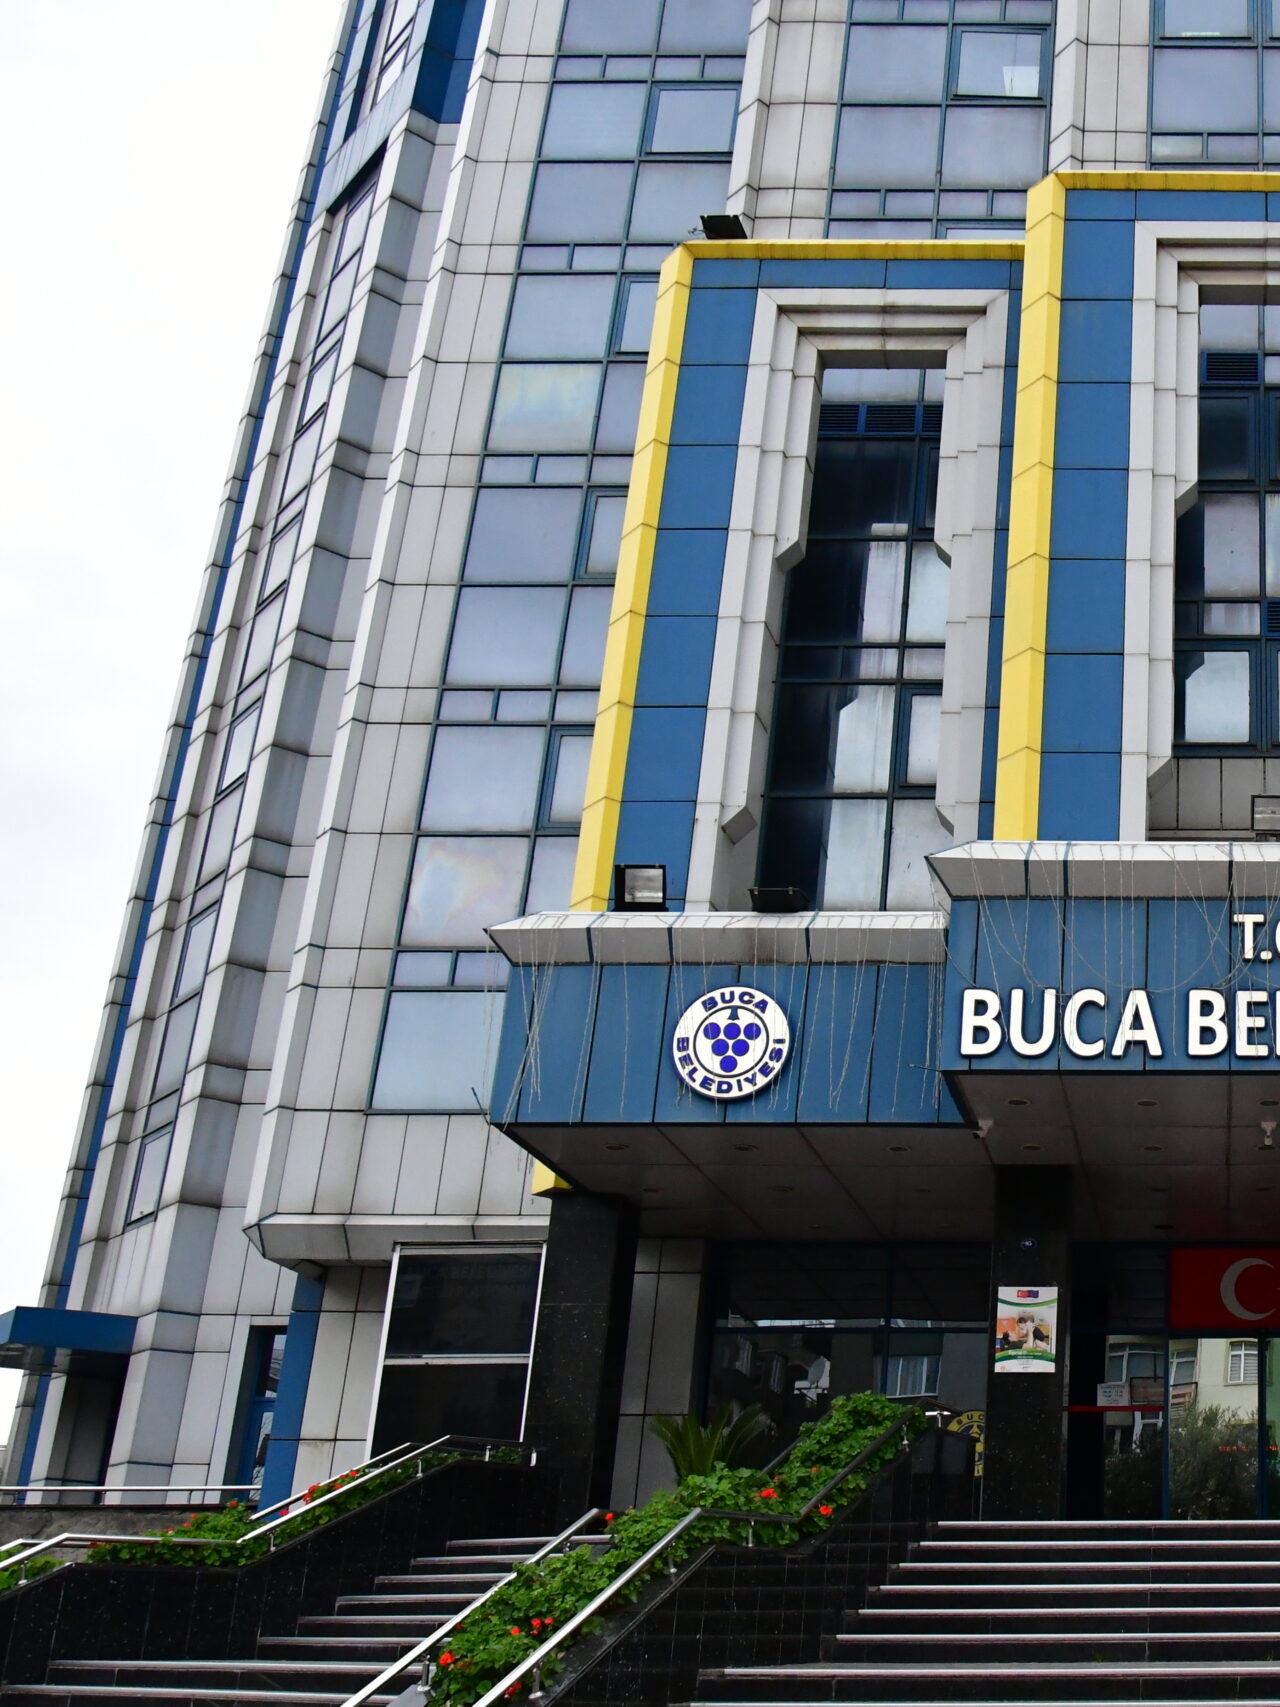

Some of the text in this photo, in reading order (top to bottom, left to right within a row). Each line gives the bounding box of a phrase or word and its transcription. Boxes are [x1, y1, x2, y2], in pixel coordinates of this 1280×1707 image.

[702, 991, 768, 1014] BUCA
[960, 987, 1163, 1058] BUCA
[956, 1413, 985, 1425] BUC
